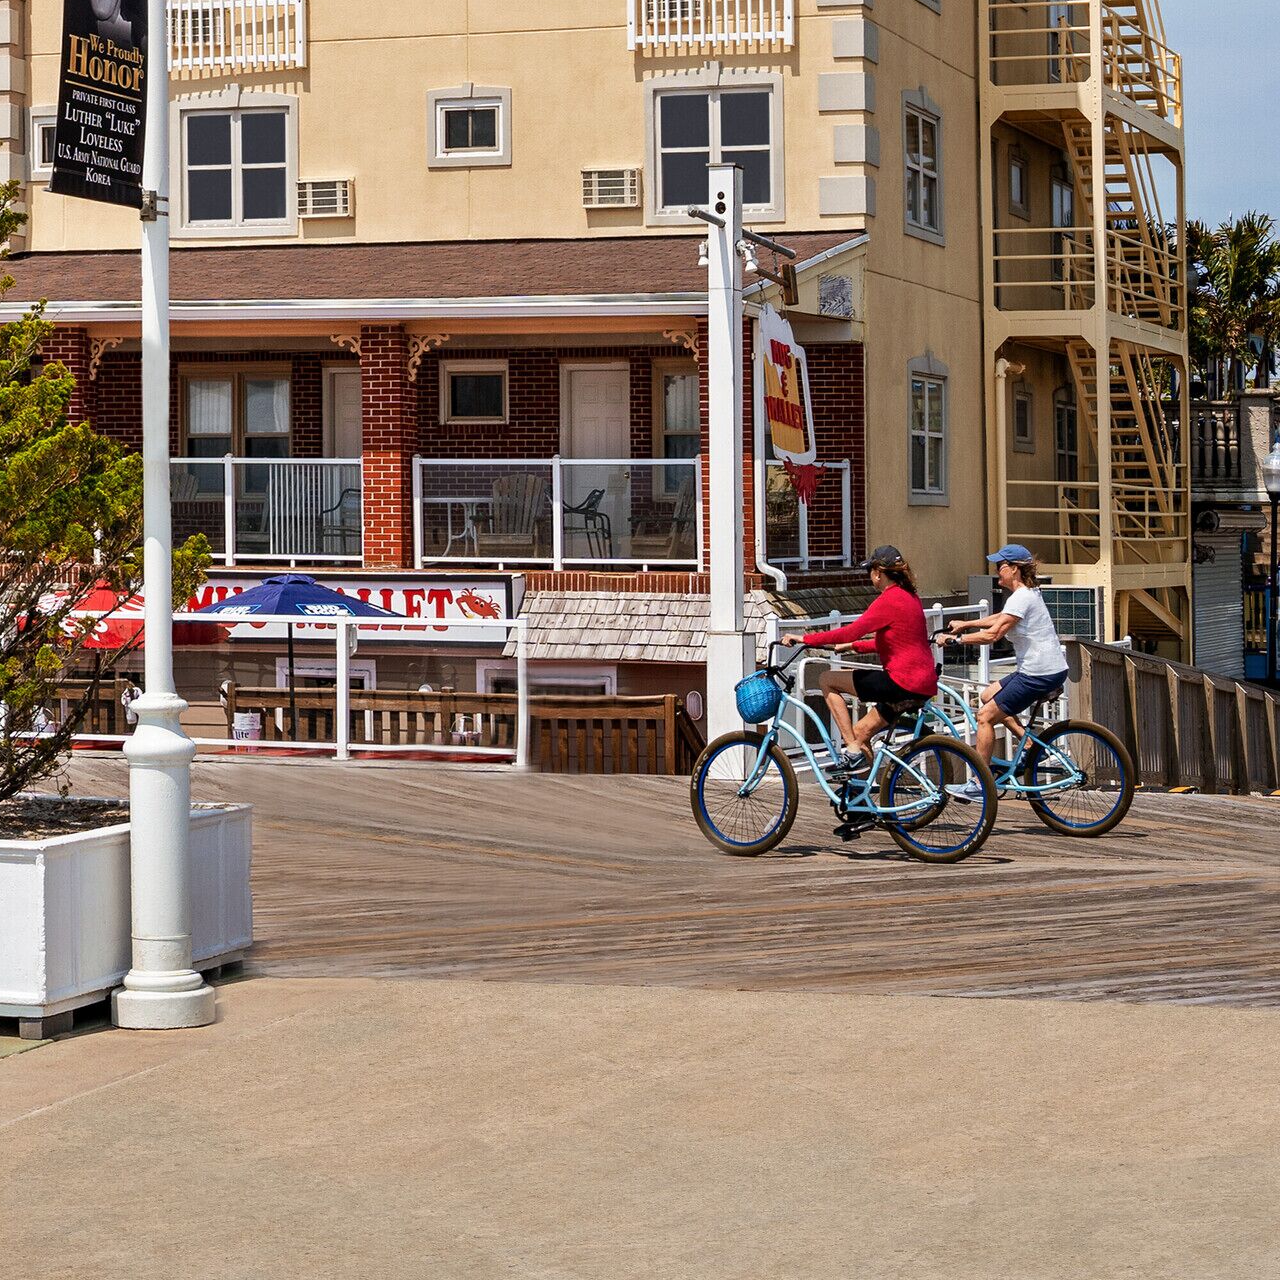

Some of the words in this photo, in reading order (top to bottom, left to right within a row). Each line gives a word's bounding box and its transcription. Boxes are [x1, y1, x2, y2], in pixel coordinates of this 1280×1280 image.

[67, 33, 144, 91] Honor
[89, 33, 104, 54] We
[107, 39, 144, 68] Proudly
[65, 102, 102, 128] LUTHER
[72, 90, 98, 105] PRIVATE
[99, 97, 116, 109] FIRST
[117, 101, 136, 114] CLASS
[58, 143, 71, 159] U.S.
[79, 126, 123, 152] LOVELESS
[85, 167, 111, 186] KOREA
